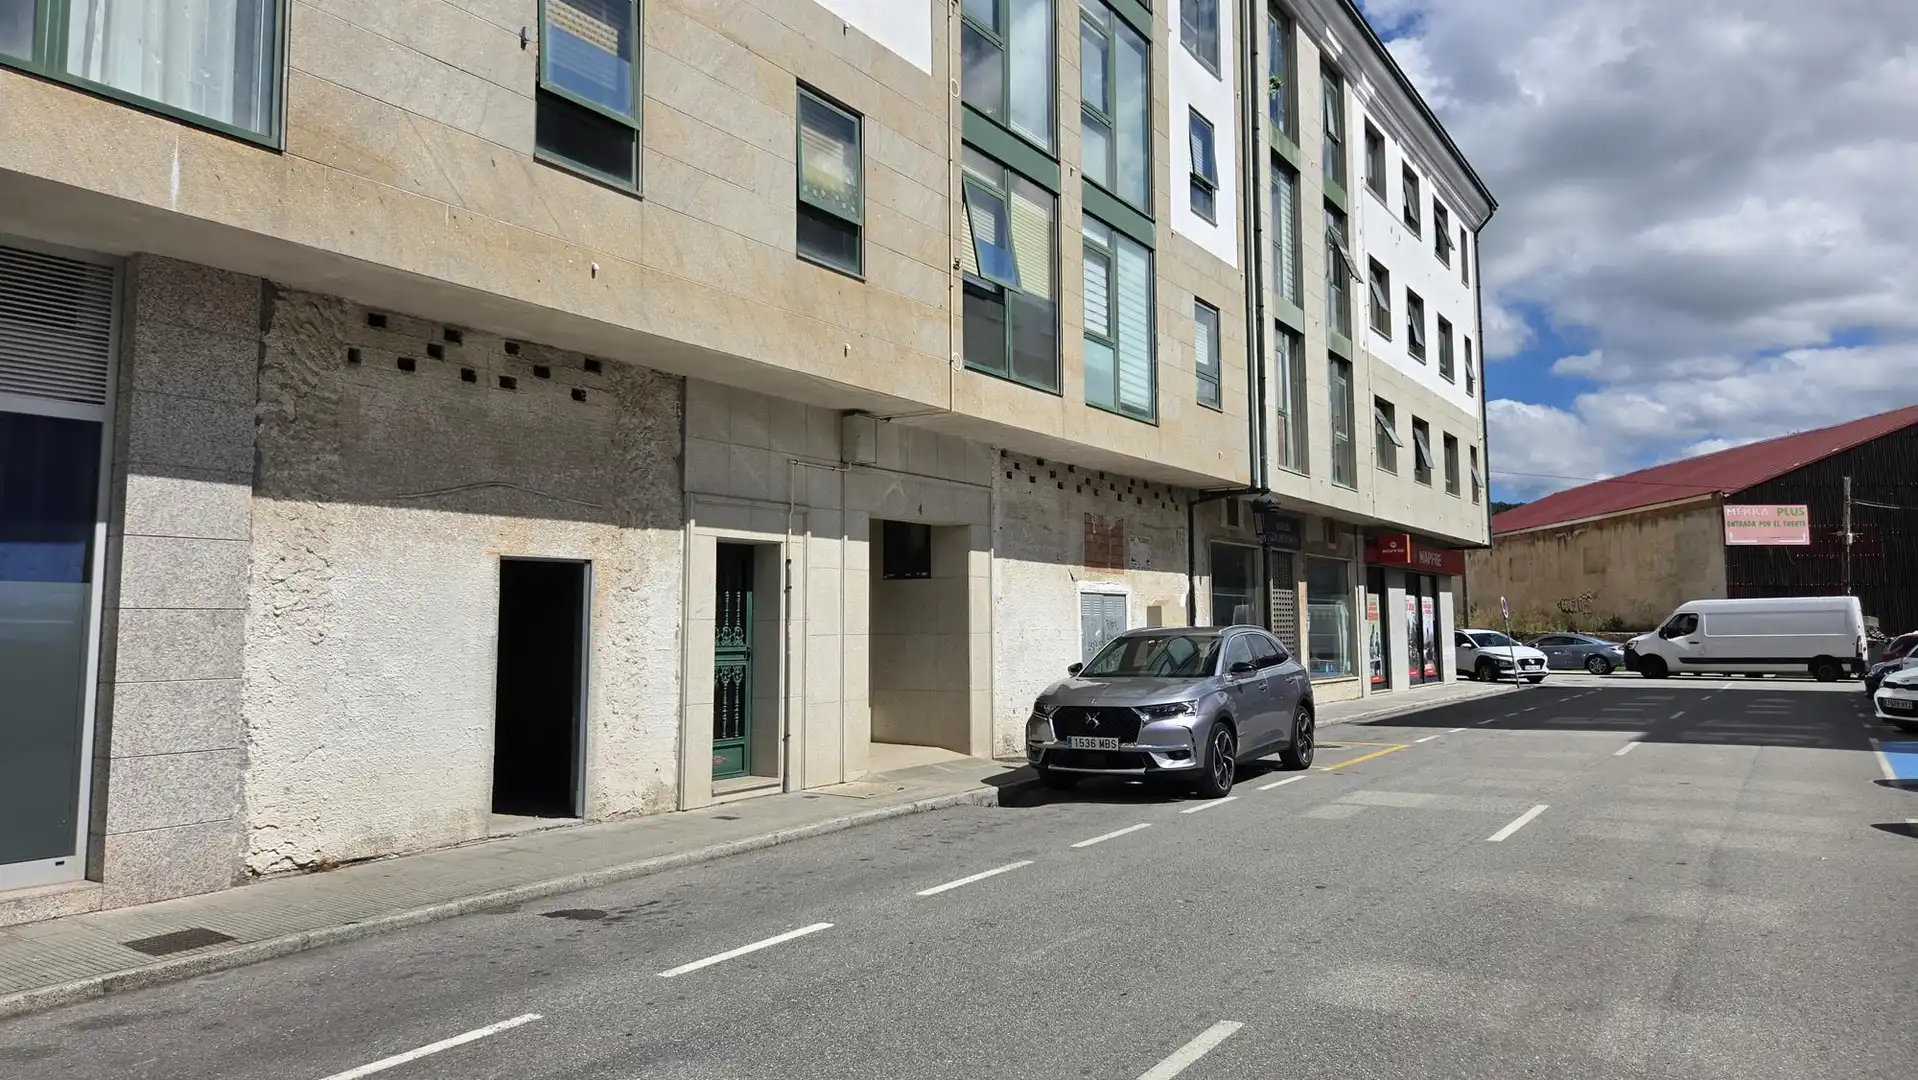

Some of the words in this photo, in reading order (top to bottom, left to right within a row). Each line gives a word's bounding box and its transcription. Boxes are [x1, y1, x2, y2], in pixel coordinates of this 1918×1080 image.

[1776, 507, 1805, 516] PLUS
[1074, 738, 1096, 748] 1536
[1099, 738, 1117, 749] MBS
